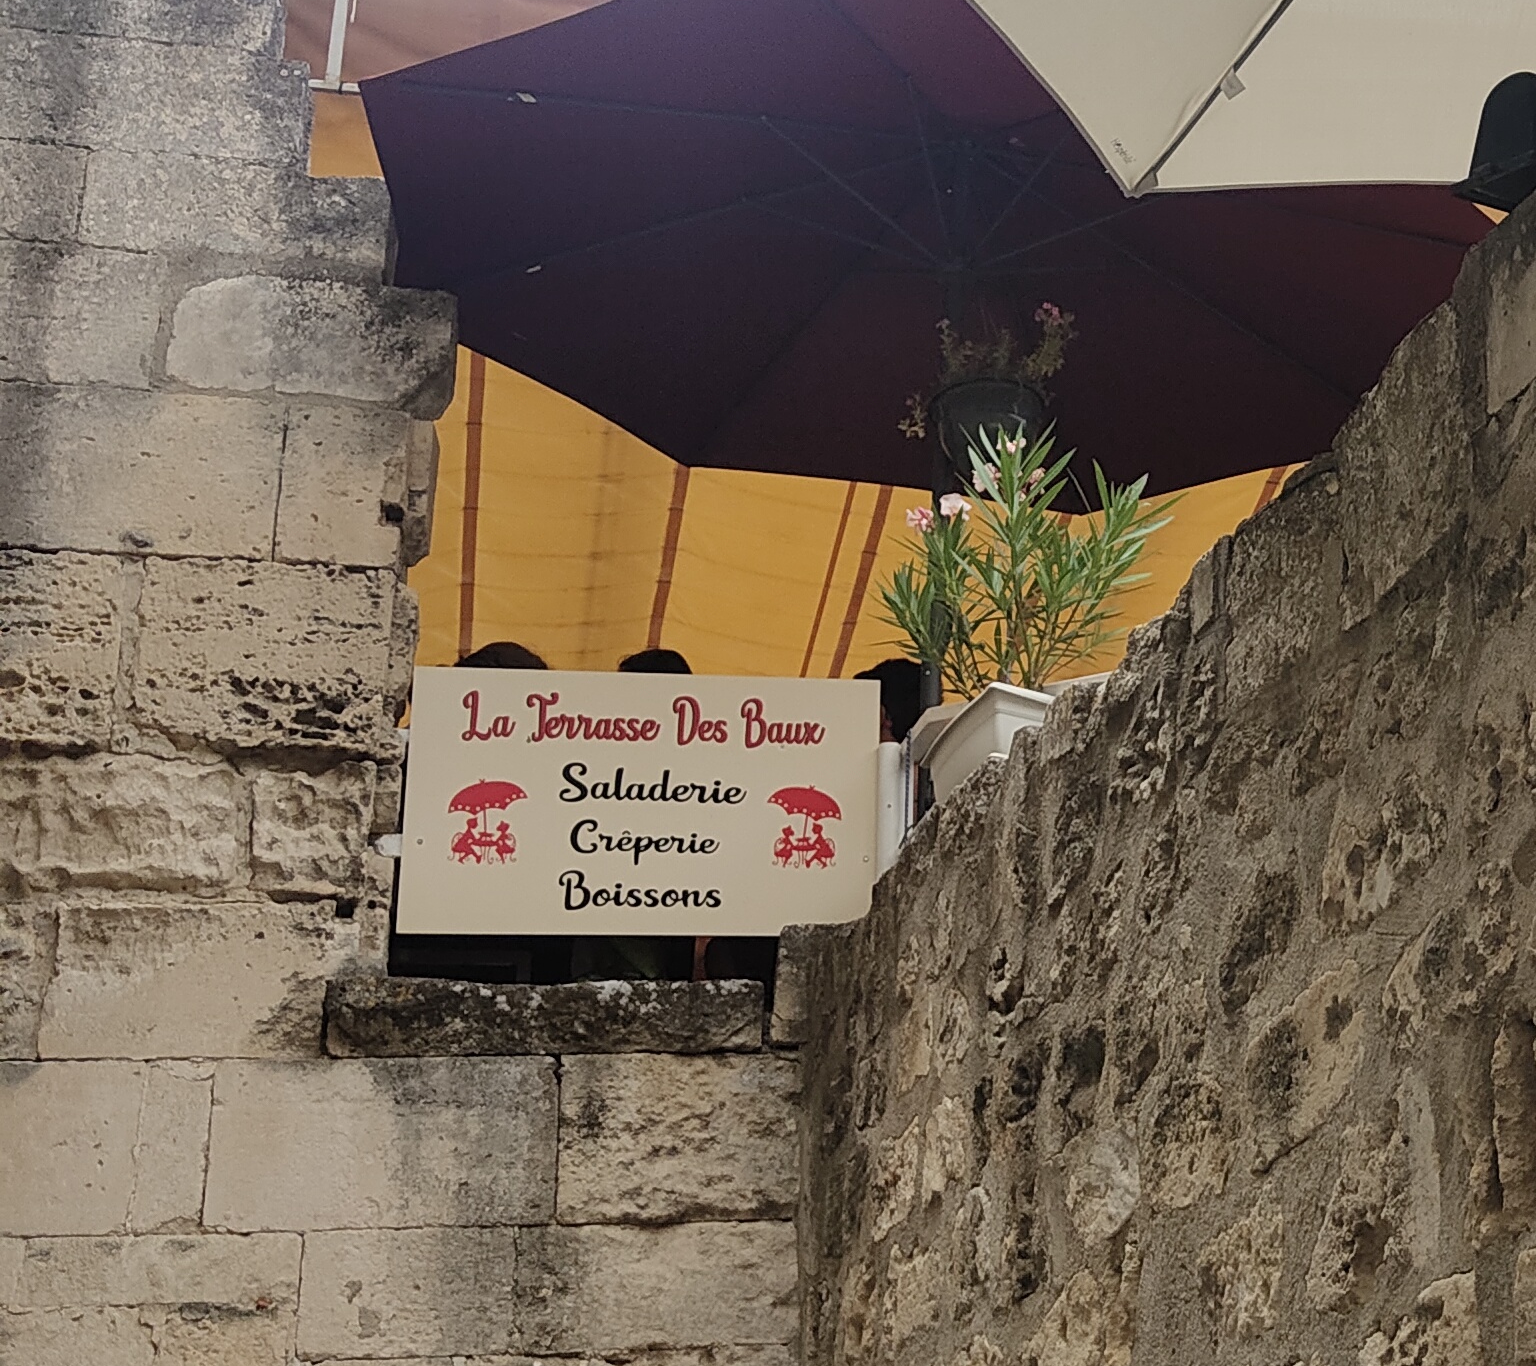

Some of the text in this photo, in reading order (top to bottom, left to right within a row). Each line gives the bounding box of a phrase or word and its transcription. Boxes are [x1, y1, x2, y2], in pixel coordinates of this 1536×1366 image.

[460, 689, 827, 749] La Terrasse Des Baux
[558, 761, 748, 804] Saladerie
[569, 819, 721, 865] Crêperie
[558, 869, 723, 911] Boissons
